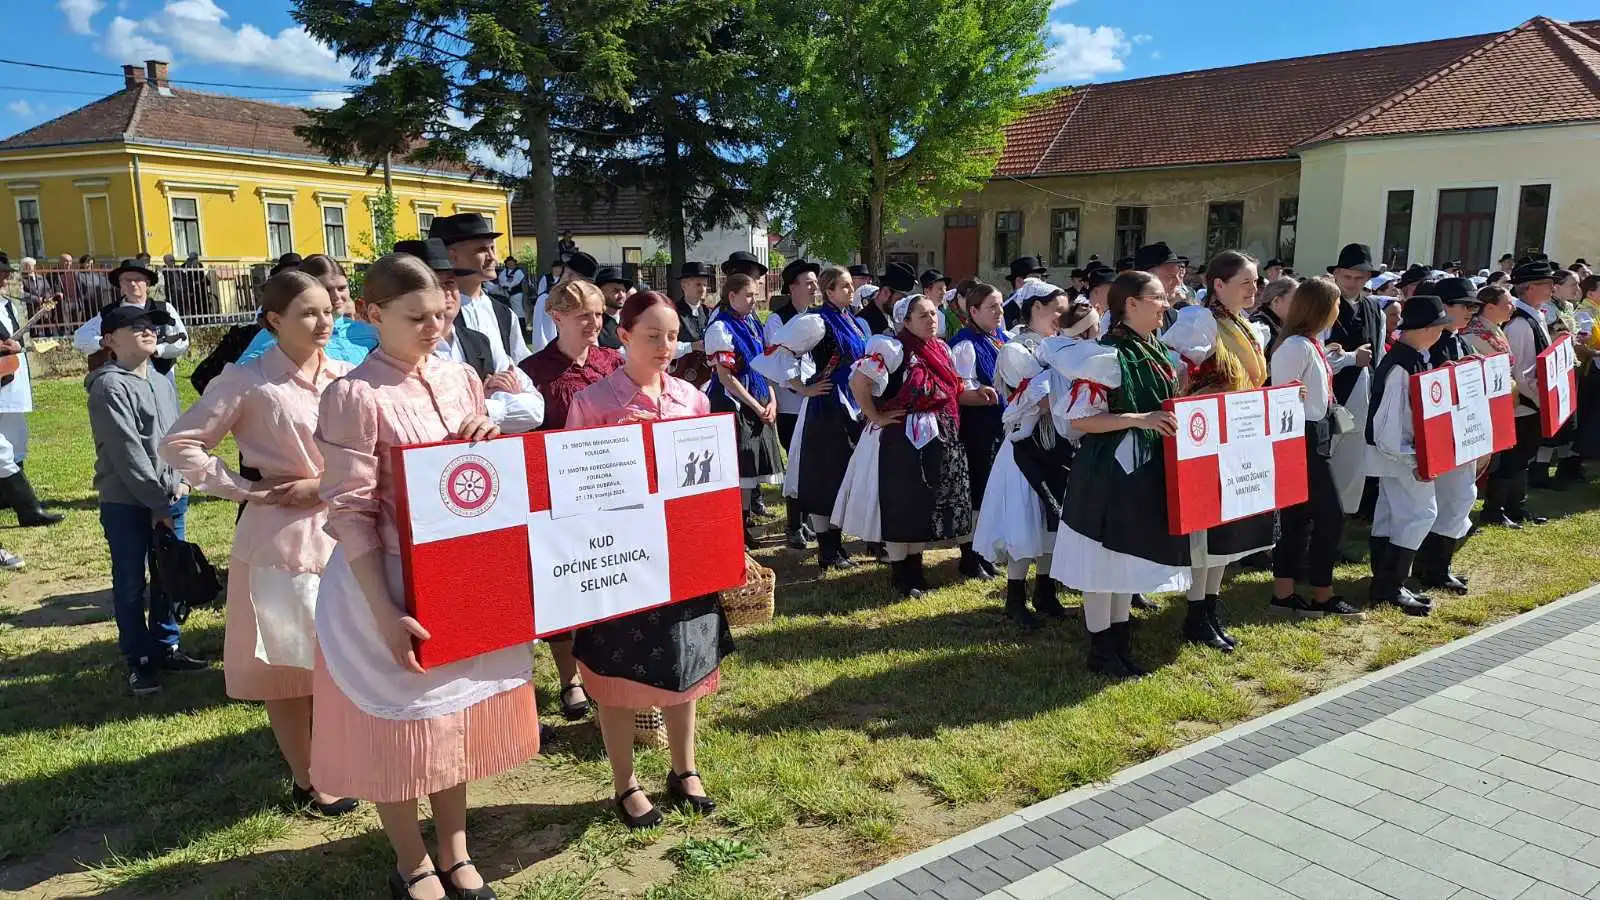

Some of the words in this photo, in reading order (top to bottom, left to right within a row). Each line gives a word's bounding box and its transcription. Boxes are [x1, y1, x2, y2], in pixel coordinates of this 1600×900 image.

[570, 440, 592, 449] SMOTRA
[584, 448, 611, 457] FOLKLORA
[567, 465, 589, 474] SMOTRA
[589, 534, 614, 549] KUD
[553, 557, 598, 577] OPĆINE
[601, 548, 650, 568] SELNICA,
[580, 572, 628, 593] SELNICA
